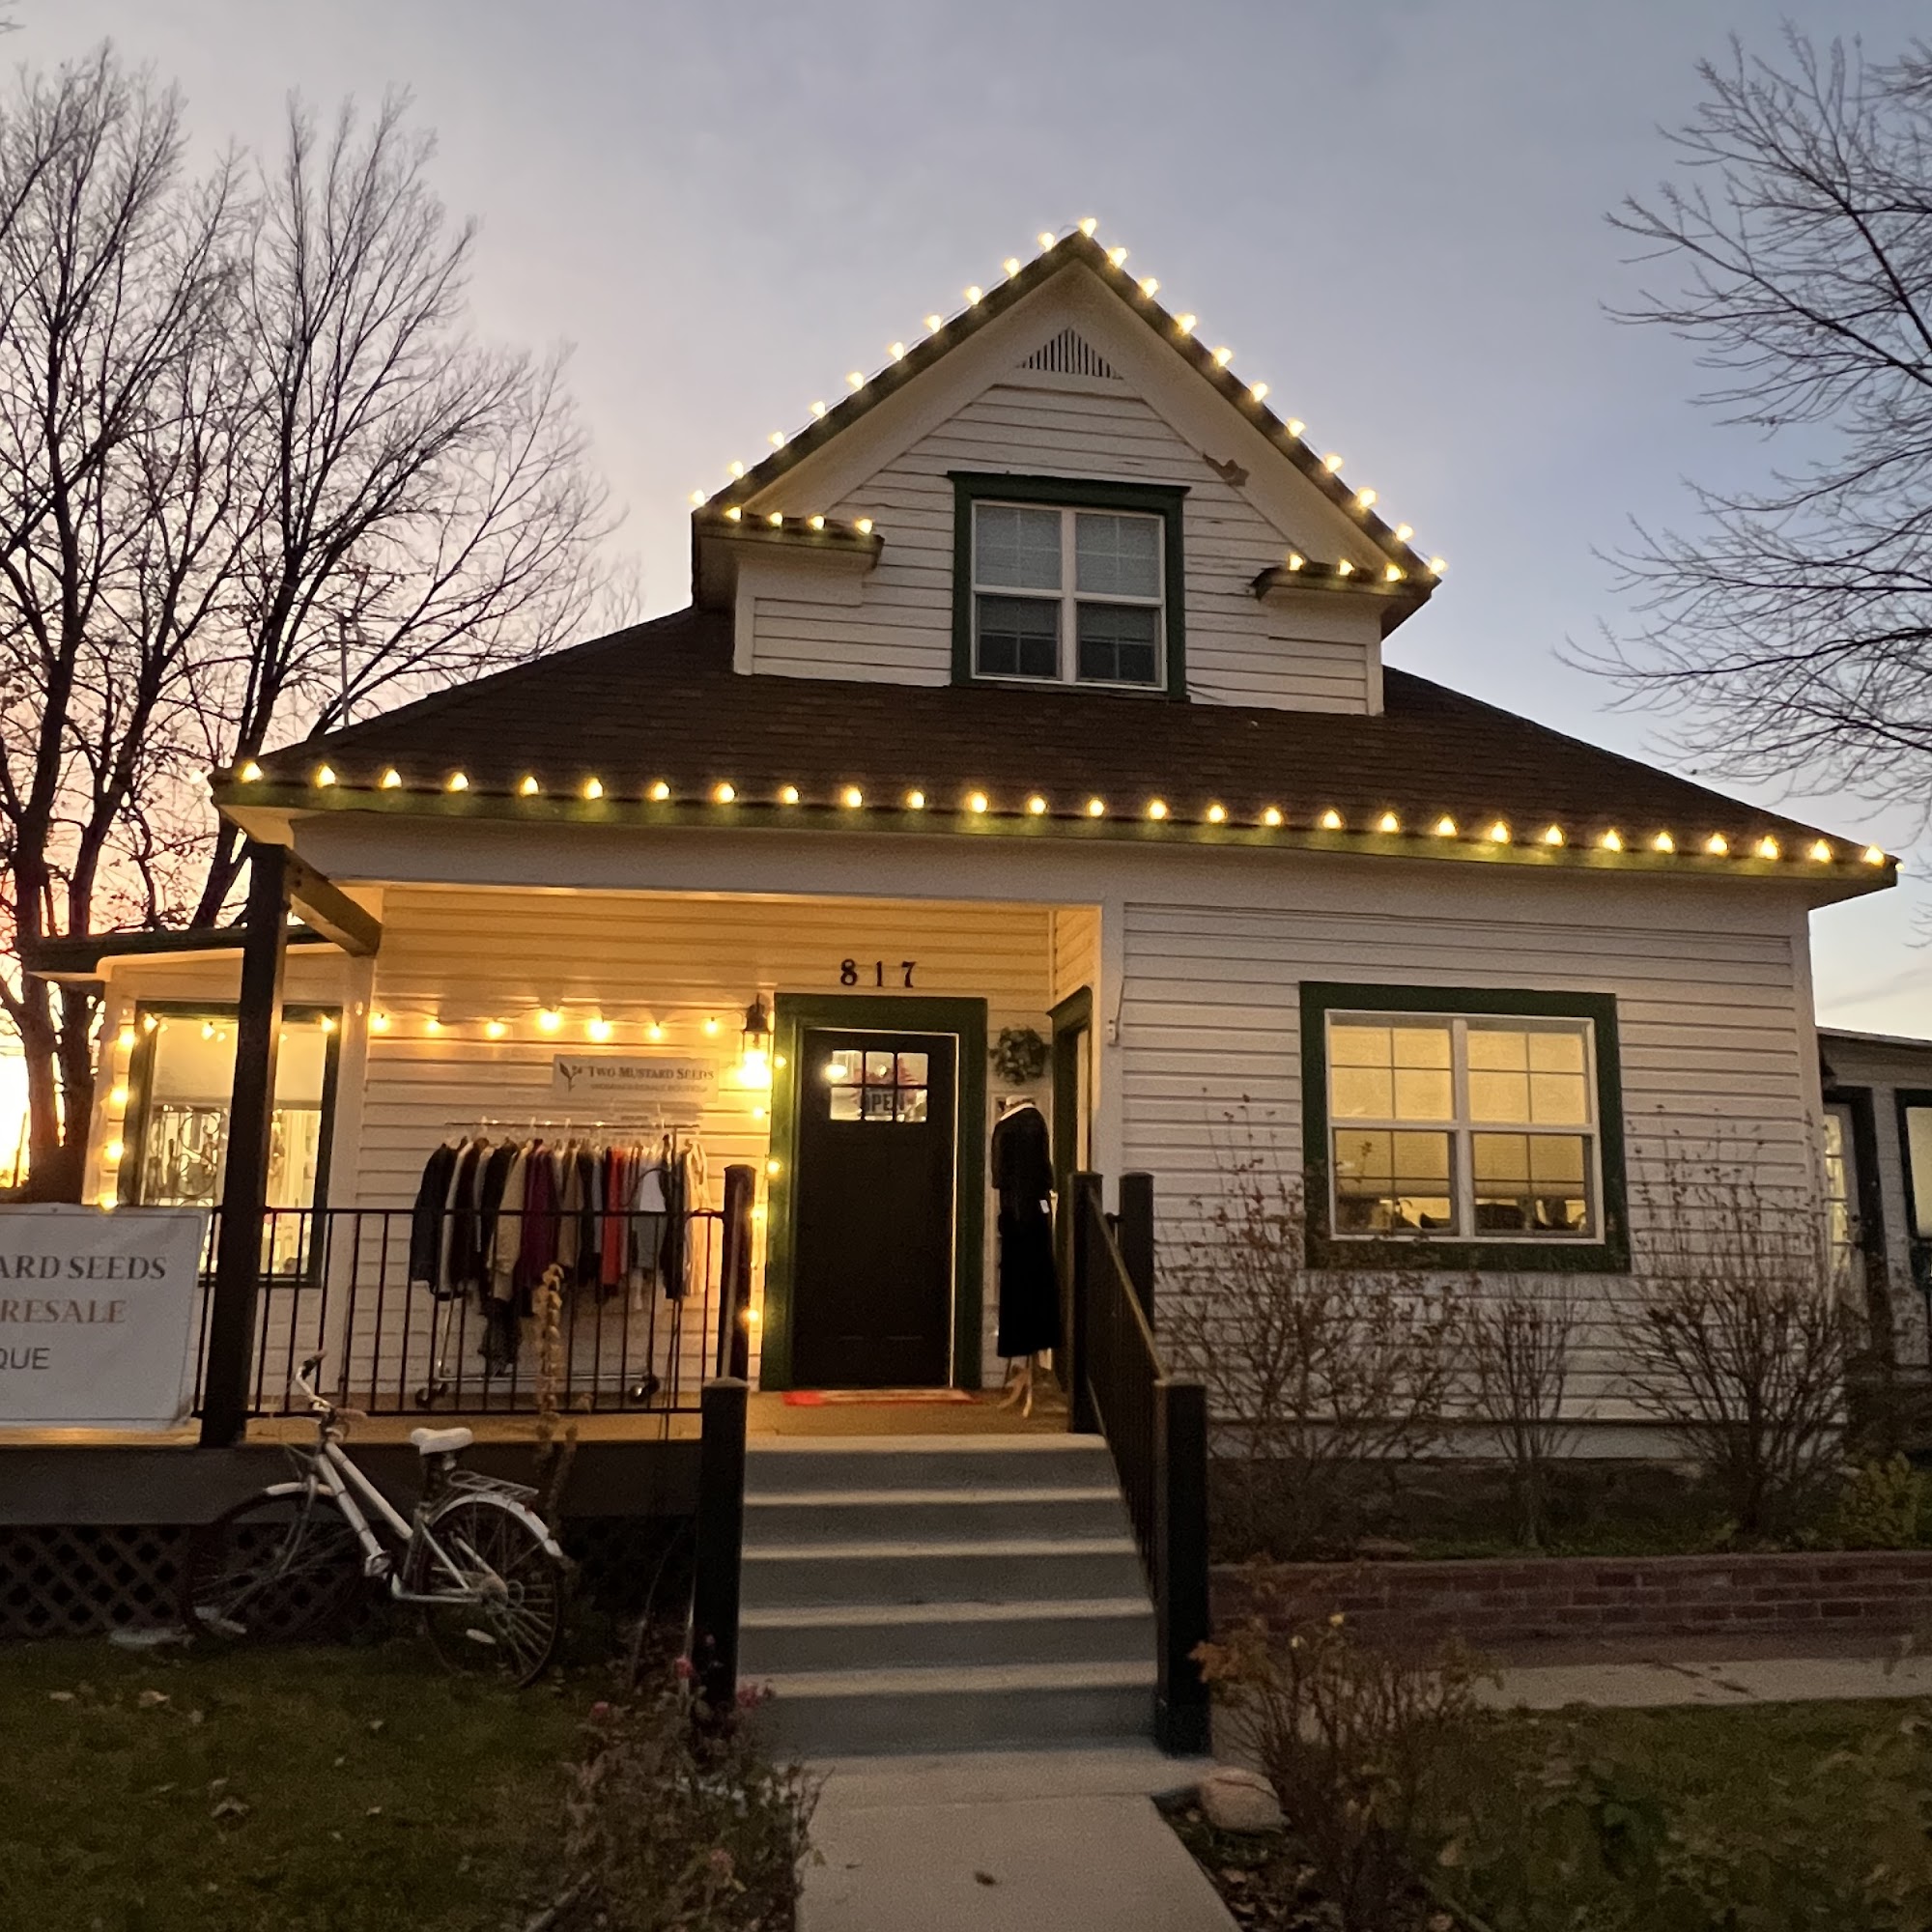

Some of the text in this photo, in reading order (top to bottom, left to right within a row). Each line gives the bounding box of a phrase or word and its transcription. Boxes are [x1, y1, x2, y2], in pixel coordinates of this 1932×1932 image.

[840, 958, 917, 988] 817
[588, 1065, 615, 1078] TWO
[619, 1066, 674, 1080] MUSTARD
[67, 1256, 167, 1280] SEEDS
[0, 1299, 126, 1324] RESALE
